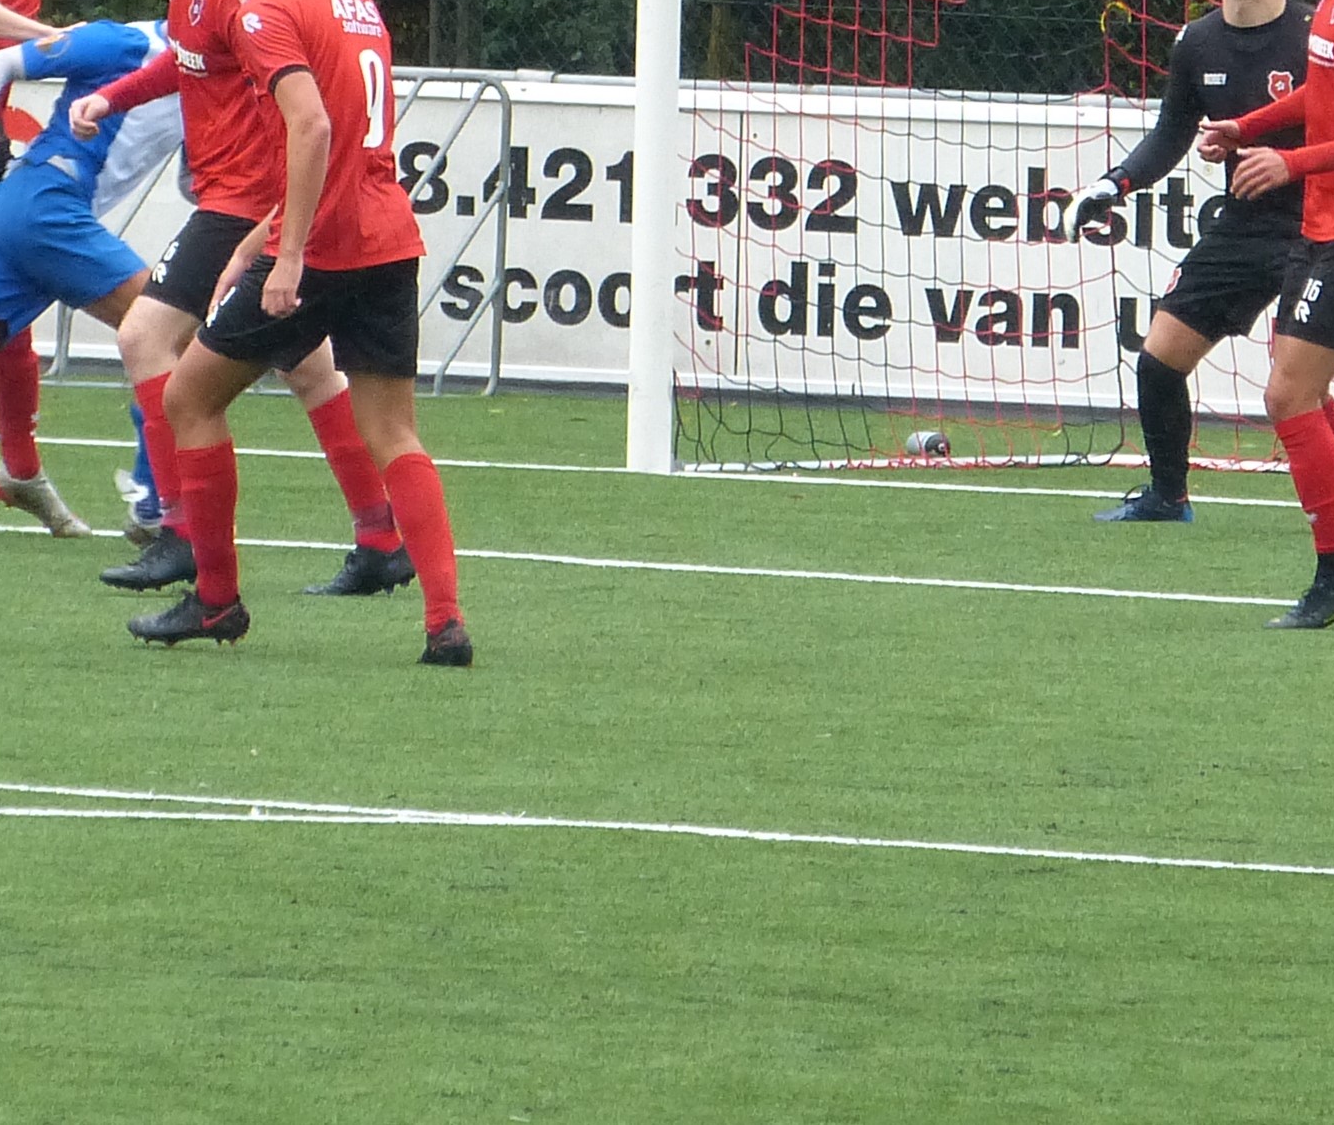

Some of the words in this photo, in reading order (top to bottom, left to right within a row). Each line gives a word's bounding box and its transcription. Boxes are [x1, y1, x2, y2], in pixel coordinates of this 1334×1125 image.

[757, 261, 893, 341] die
[925, 287, 1080, 350] van
[1302, 277, 1323, 302] 16
